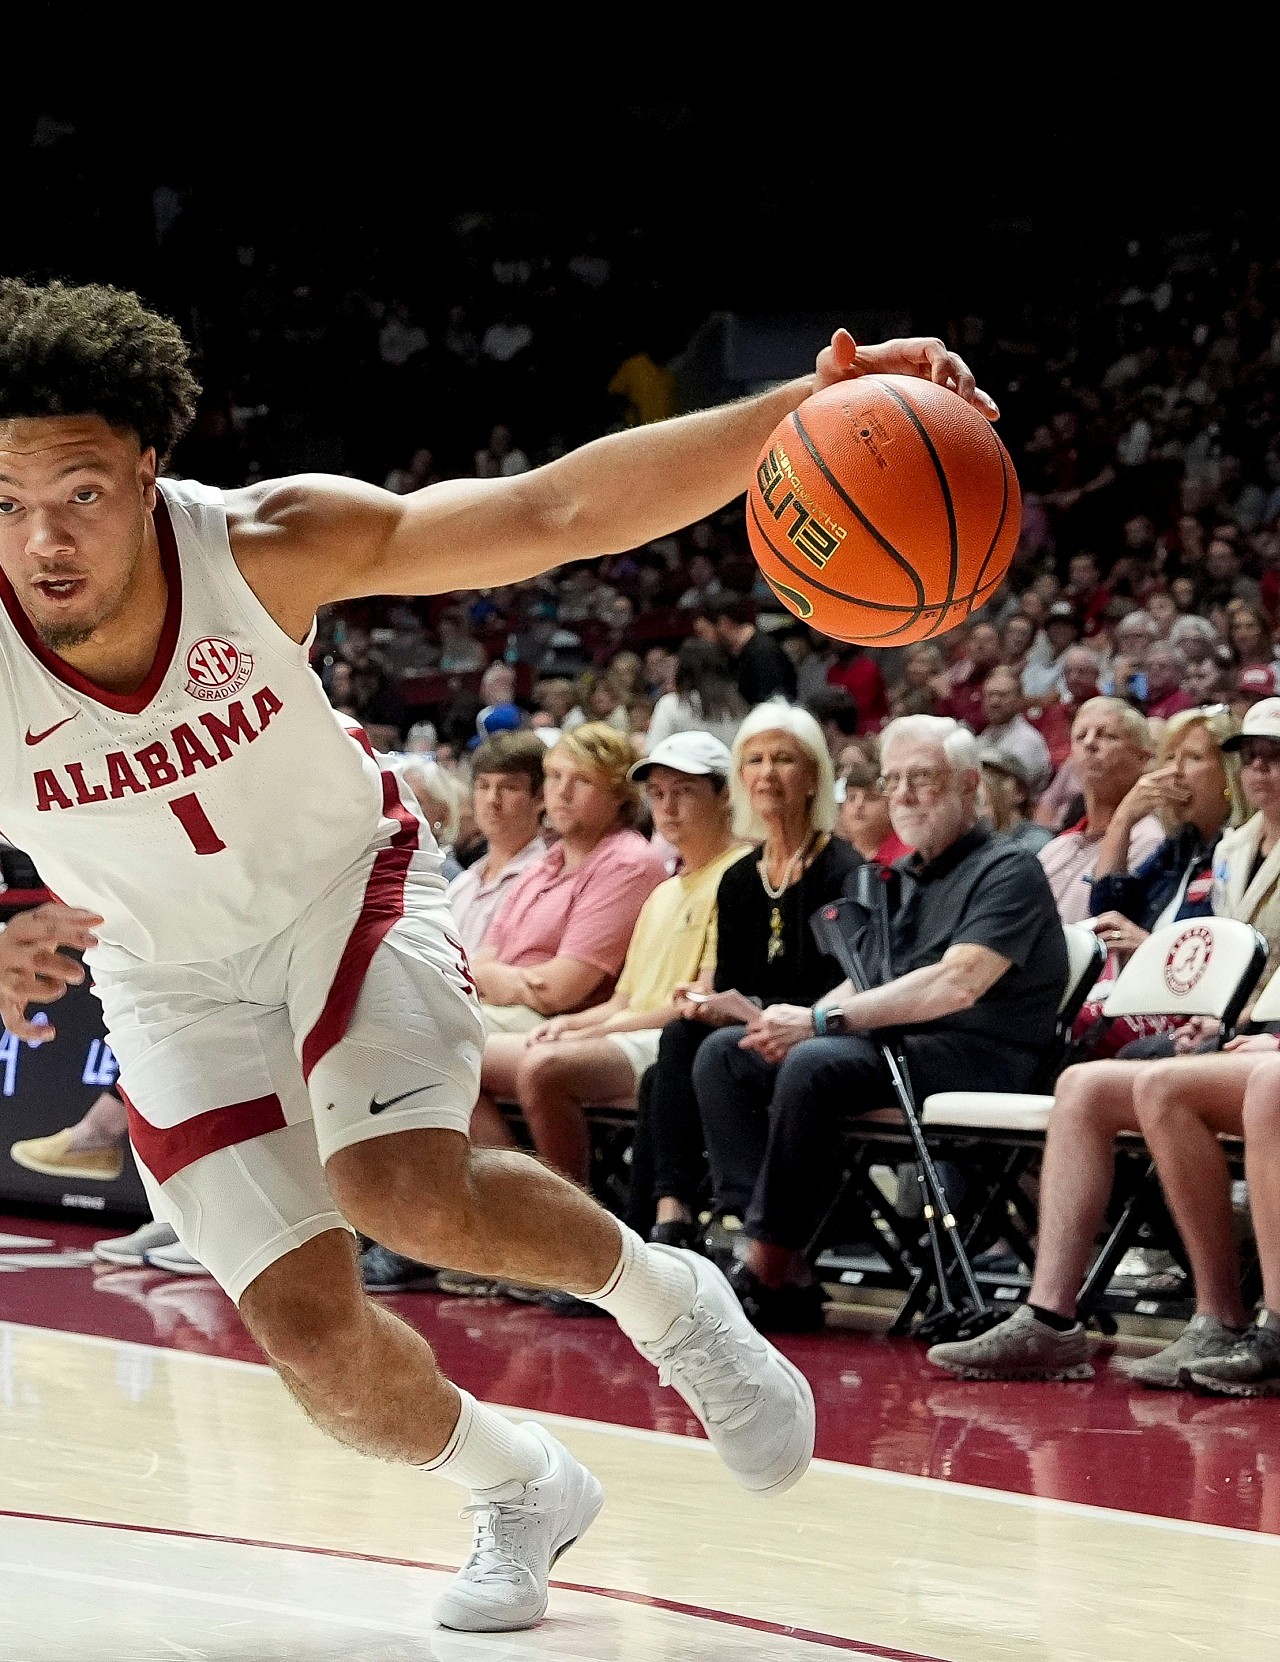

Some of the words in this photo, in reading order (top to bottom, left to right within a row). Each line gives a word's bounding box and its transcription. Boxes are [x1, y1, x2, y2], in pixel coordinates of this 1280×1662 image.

[757, 448, 841, 571] ELITE
[188, 639, 238, 686] SEC
[197, 667, 250, 700] GRADUATE
[33, 686, 284, 811] ALABAMA
[167, 792, 227, 856] 1
